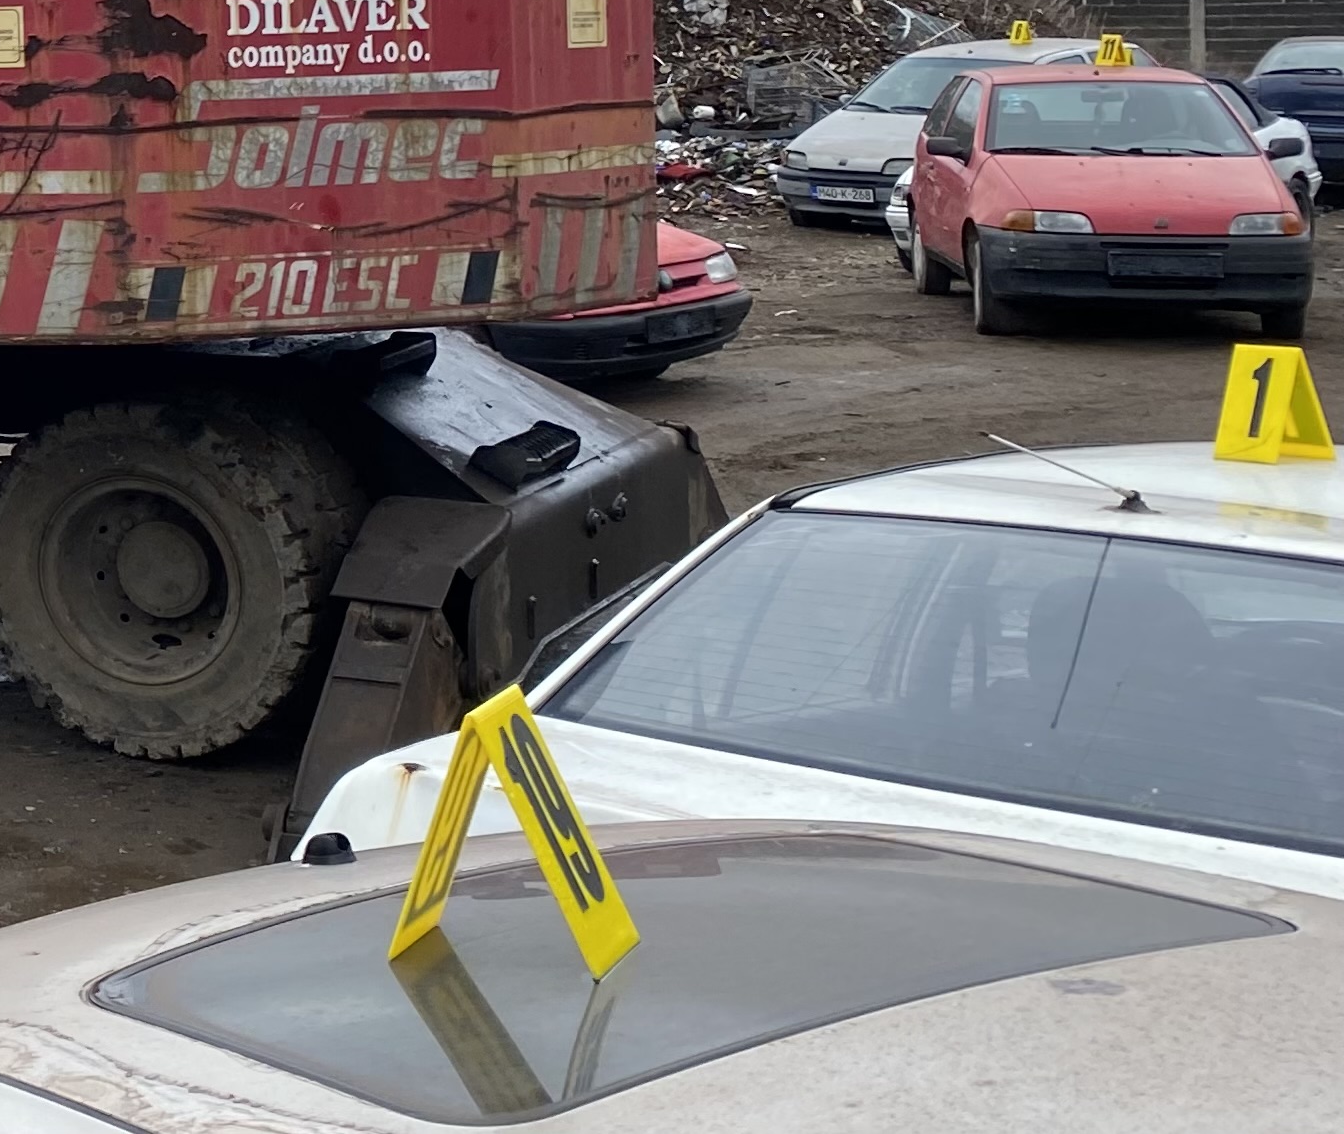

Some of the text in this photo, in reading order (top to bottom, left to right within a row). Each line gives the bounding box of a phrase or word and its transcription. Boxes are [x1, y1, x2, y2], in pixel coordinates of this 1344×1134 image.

[227, 35, 431, 74] company d.o.o.
[1102, 38, 1117, 60] 11
[230, 254, 418, 317] 210 ESC
[1248, 357, 1275, 438] 1
[499, 713, 606, 914] 19
